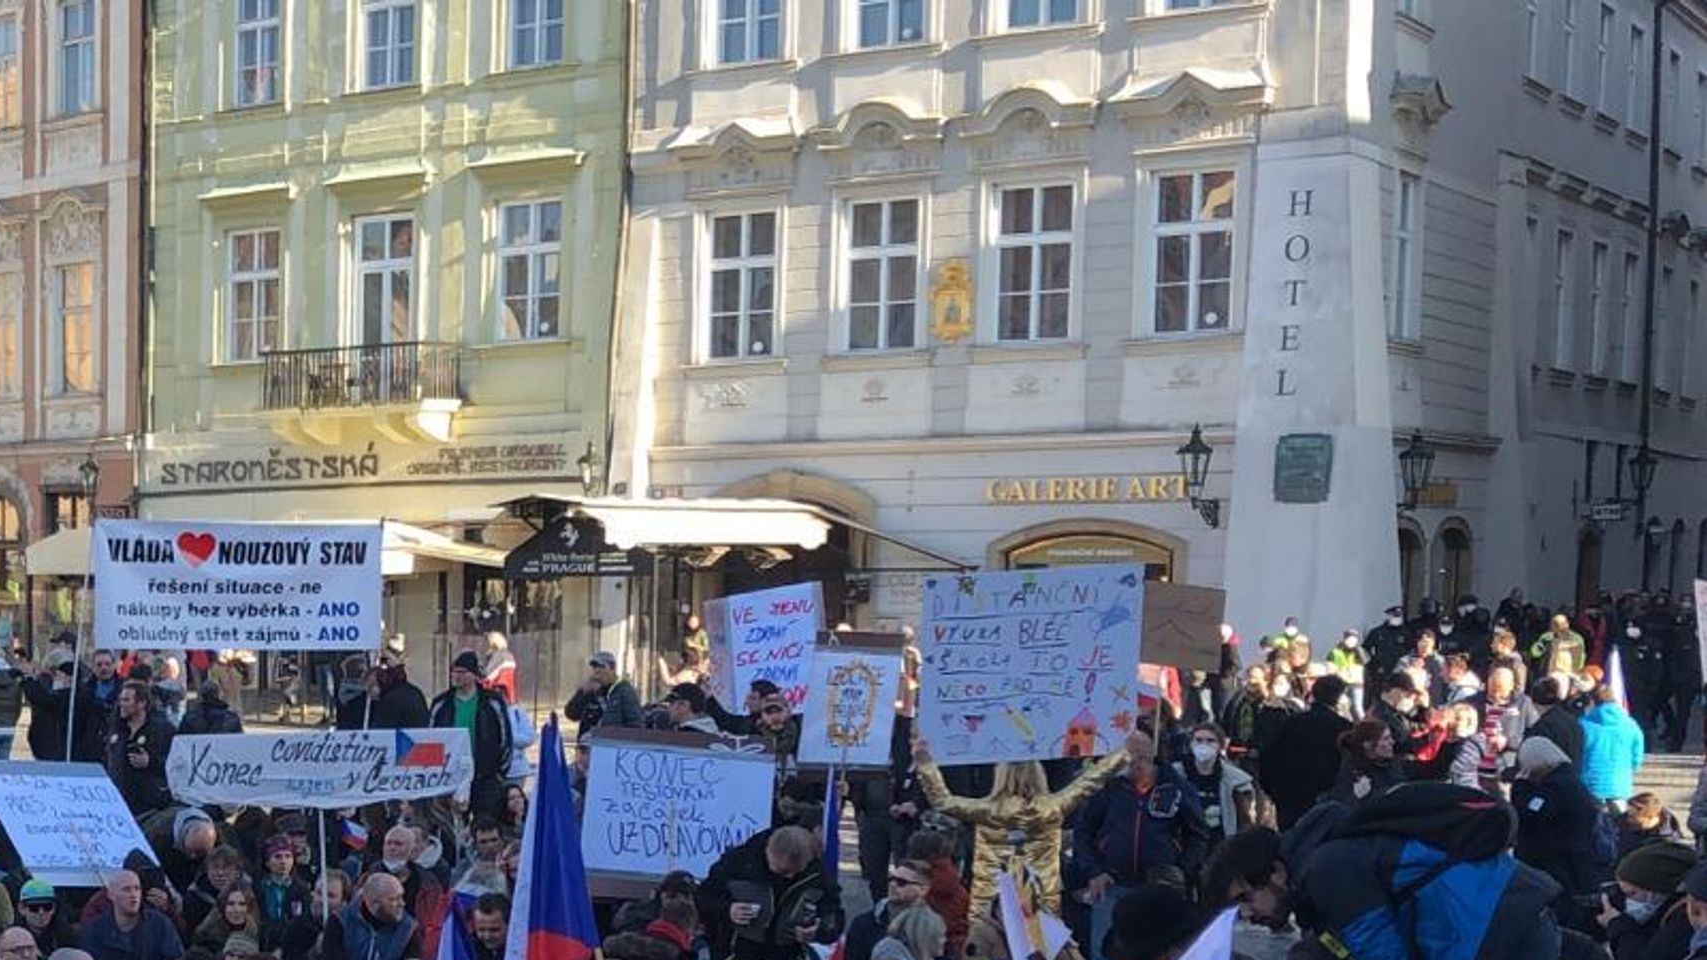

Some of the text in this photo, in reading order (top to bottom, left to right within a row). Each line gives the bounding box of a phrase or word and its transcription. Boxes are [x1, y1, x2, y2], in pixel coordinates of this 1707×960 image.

[1274, 189, 1313, 398] HOTEL
[161, 441, 380, 485] STAROMĚSTSKÁ
[985, 477, 1116, 502] GALERIE
[217, 537, 310, 565] NOUZOVÝ
[320, 540, 367, 565] STAV
[542, 562, 596, 573] PRAGUE
[148, 577, 209, 595] řešení
[215, 579, 284, 595] situace
[300, 584, 322, 595] ne
[117, 602, 182, 621] nákupy
[188, 602, 221, 617] bez
[318, 601, 360, 618] ANO
[195, 626, 239, 642] střet
[318, 625, 360, 642] ANO
[188, 741, 263, 787] Konec
[615, 750, 724, 786] KONEC
